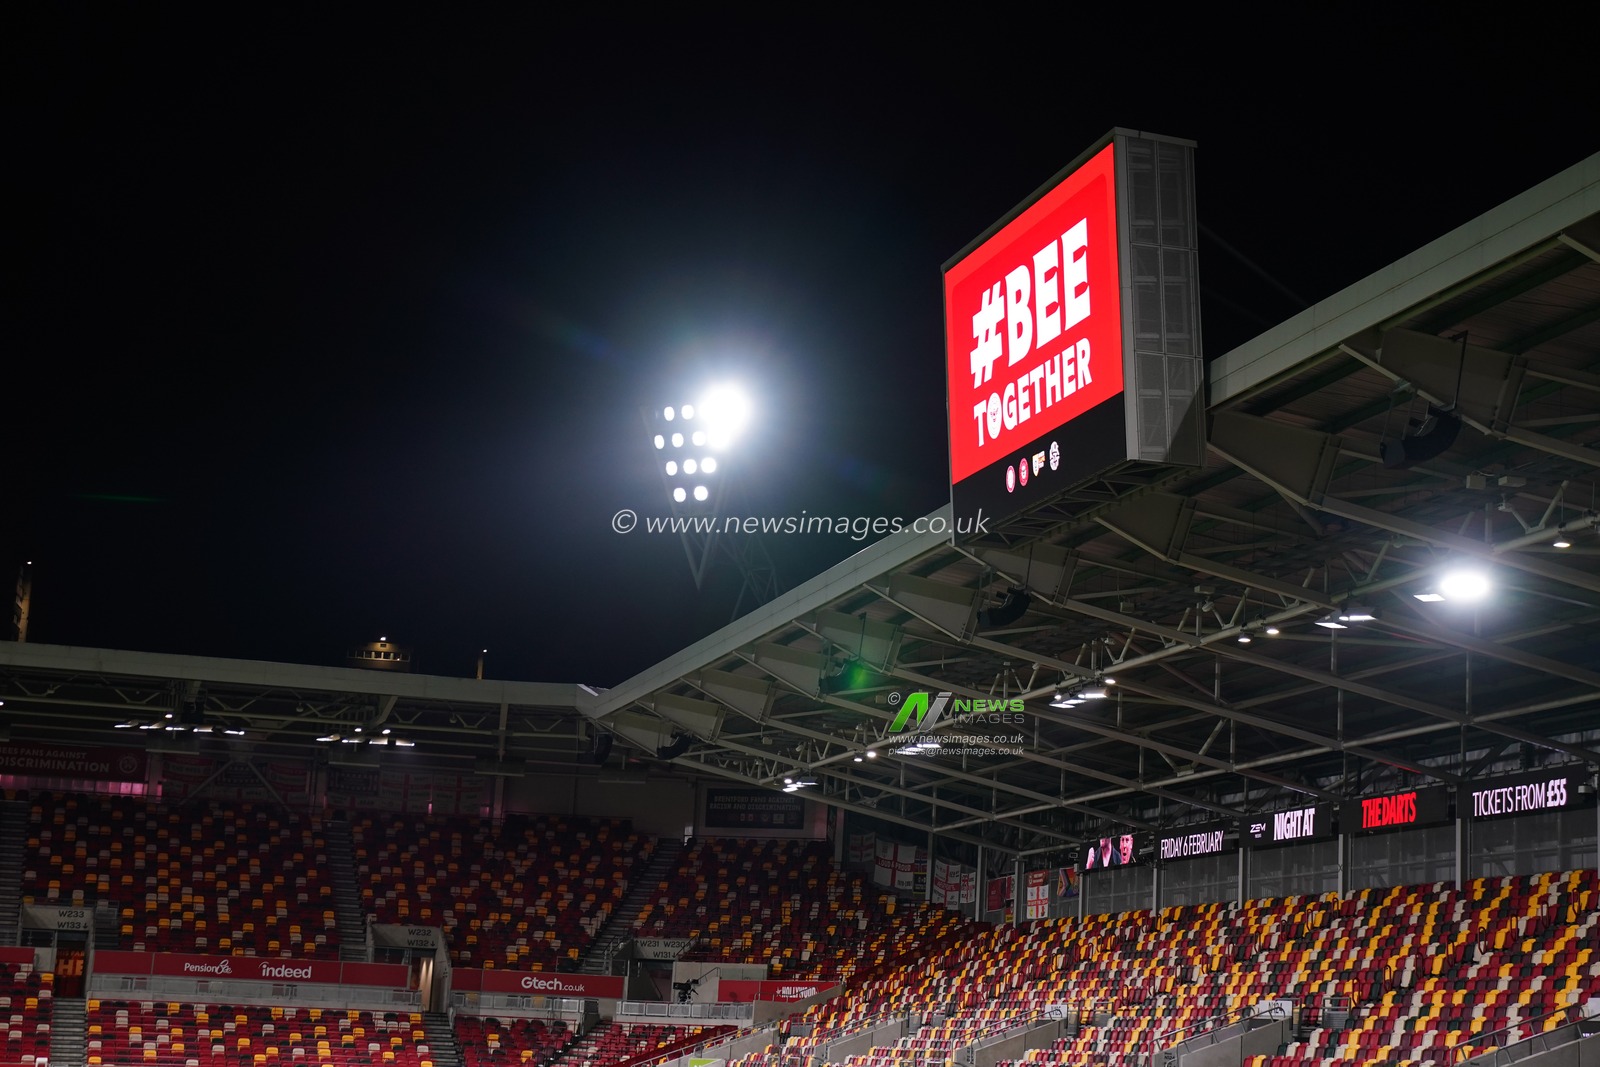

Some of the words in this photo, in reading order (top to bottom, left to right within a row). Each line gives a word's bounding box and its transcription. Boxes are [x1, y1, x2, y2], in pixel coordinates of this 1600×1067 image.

[969, 217, 1091, 390] #BEE
[973, 337, 1093, 447] TOGETHER
[45, 750, 87, 759] AGAINST
[1472, 786, 1514, 817] TICKETS
[1515, 782, 1546, 812] FROM
[1546, 777, 1567, 808] £55
[1361, 797, 1382, 829] THE
[1382, 791, 1417, 826] DARTS
[1273, 810, 1303, 841] NIGHT
[1302, 808, 1316, 837] AT
[1160, 838, 1184, 859] FRIDAY
[1182, 839, 1190, 856] 6
[1189, 830, 1224, 855] FEBRUARY
[58, 910, 85, 918] W233
[57, 921, 81, 929] W133
[407, 928, 432, 937] W232
[407, 939, 429, 947] W132
[653, 951, 671, 959] W131
[184, 959, 233, 975] PensionBee
[259, 962, 313, 979] indeed
[521, 976, 585, 992] Gtech.co.uk
